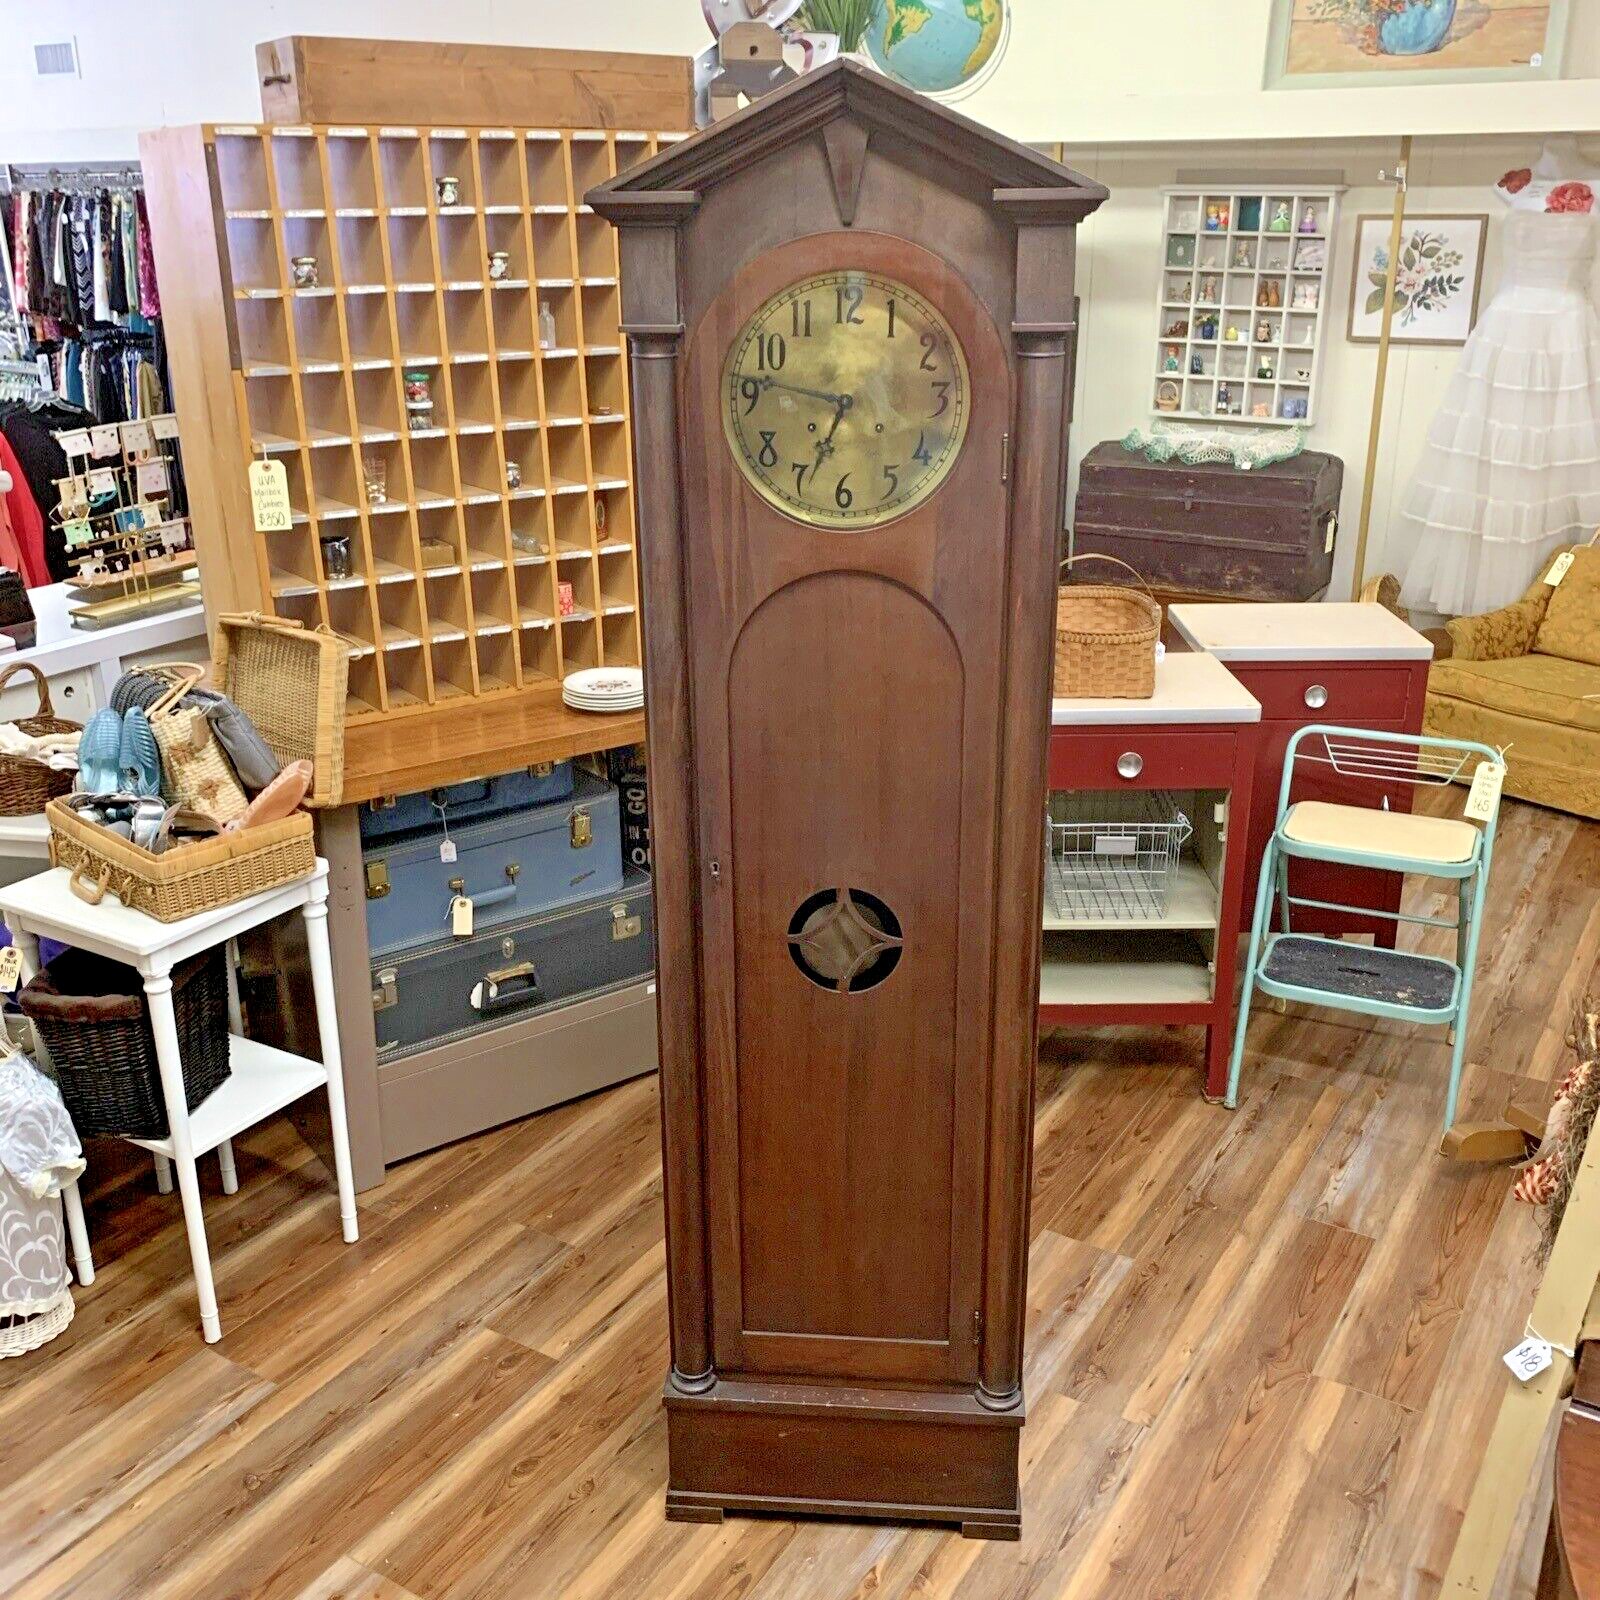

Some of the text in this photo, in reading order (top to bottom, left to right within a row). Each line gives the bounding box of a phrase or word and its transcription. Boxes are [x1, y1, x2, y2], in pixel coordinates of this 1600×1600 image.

[791, 299, 812, 337] 11
[835, 286, 864, 325] 12
[887, 299, 896, 338] 1
[757, 332, 786, 371] 10
[919, 332, 938, 372] 2
[741, 378, 760, 416] 9
[927, 381, 950, 419] 3
[758, 430, 777, 467] 8
[911, 430, 933, 466] 4
[258, 475, 276, 486] UVA
[791, 463, 809, 497] 7
[835, 472, 853, 509] 6
[880, 464, 900, 501] 5
[259, 511, 286, 527] $350
[1515, 1346, 1543, 1372] $18
